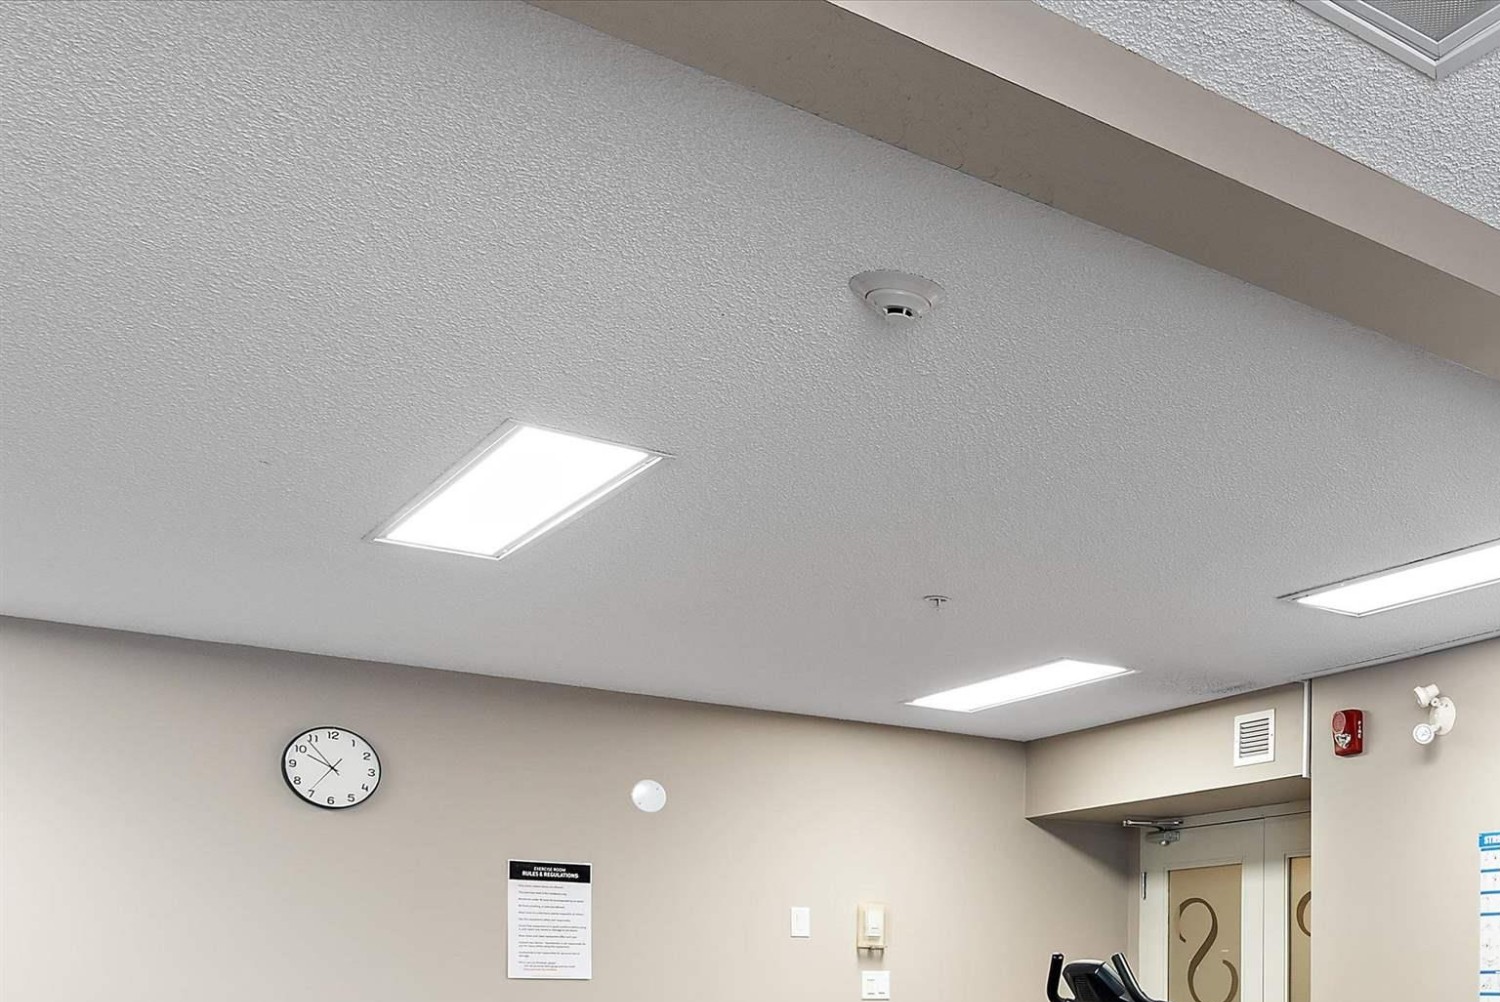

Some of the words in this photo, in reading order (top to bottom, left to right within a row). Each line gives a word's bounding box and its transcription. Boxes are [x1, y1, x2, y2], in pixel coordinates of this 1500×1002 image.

[327, 731, 340, 740] 12
[351, 739, 356, 747] 1
[294, 744, 307, 754] 10
[362, 751, 371, 761] 2
[288, 759, 297, 768] 9
[367, 768, 376, 777] 3
[293, 776, 302, 785] 8
[361, 783, 369, 792] 4
[307, 789, 315, 798] 7
[347, 793, 356, 803] 5
[327, 796, 335, 805] 6
[544, 871, 579, 879] REGULATIONS
